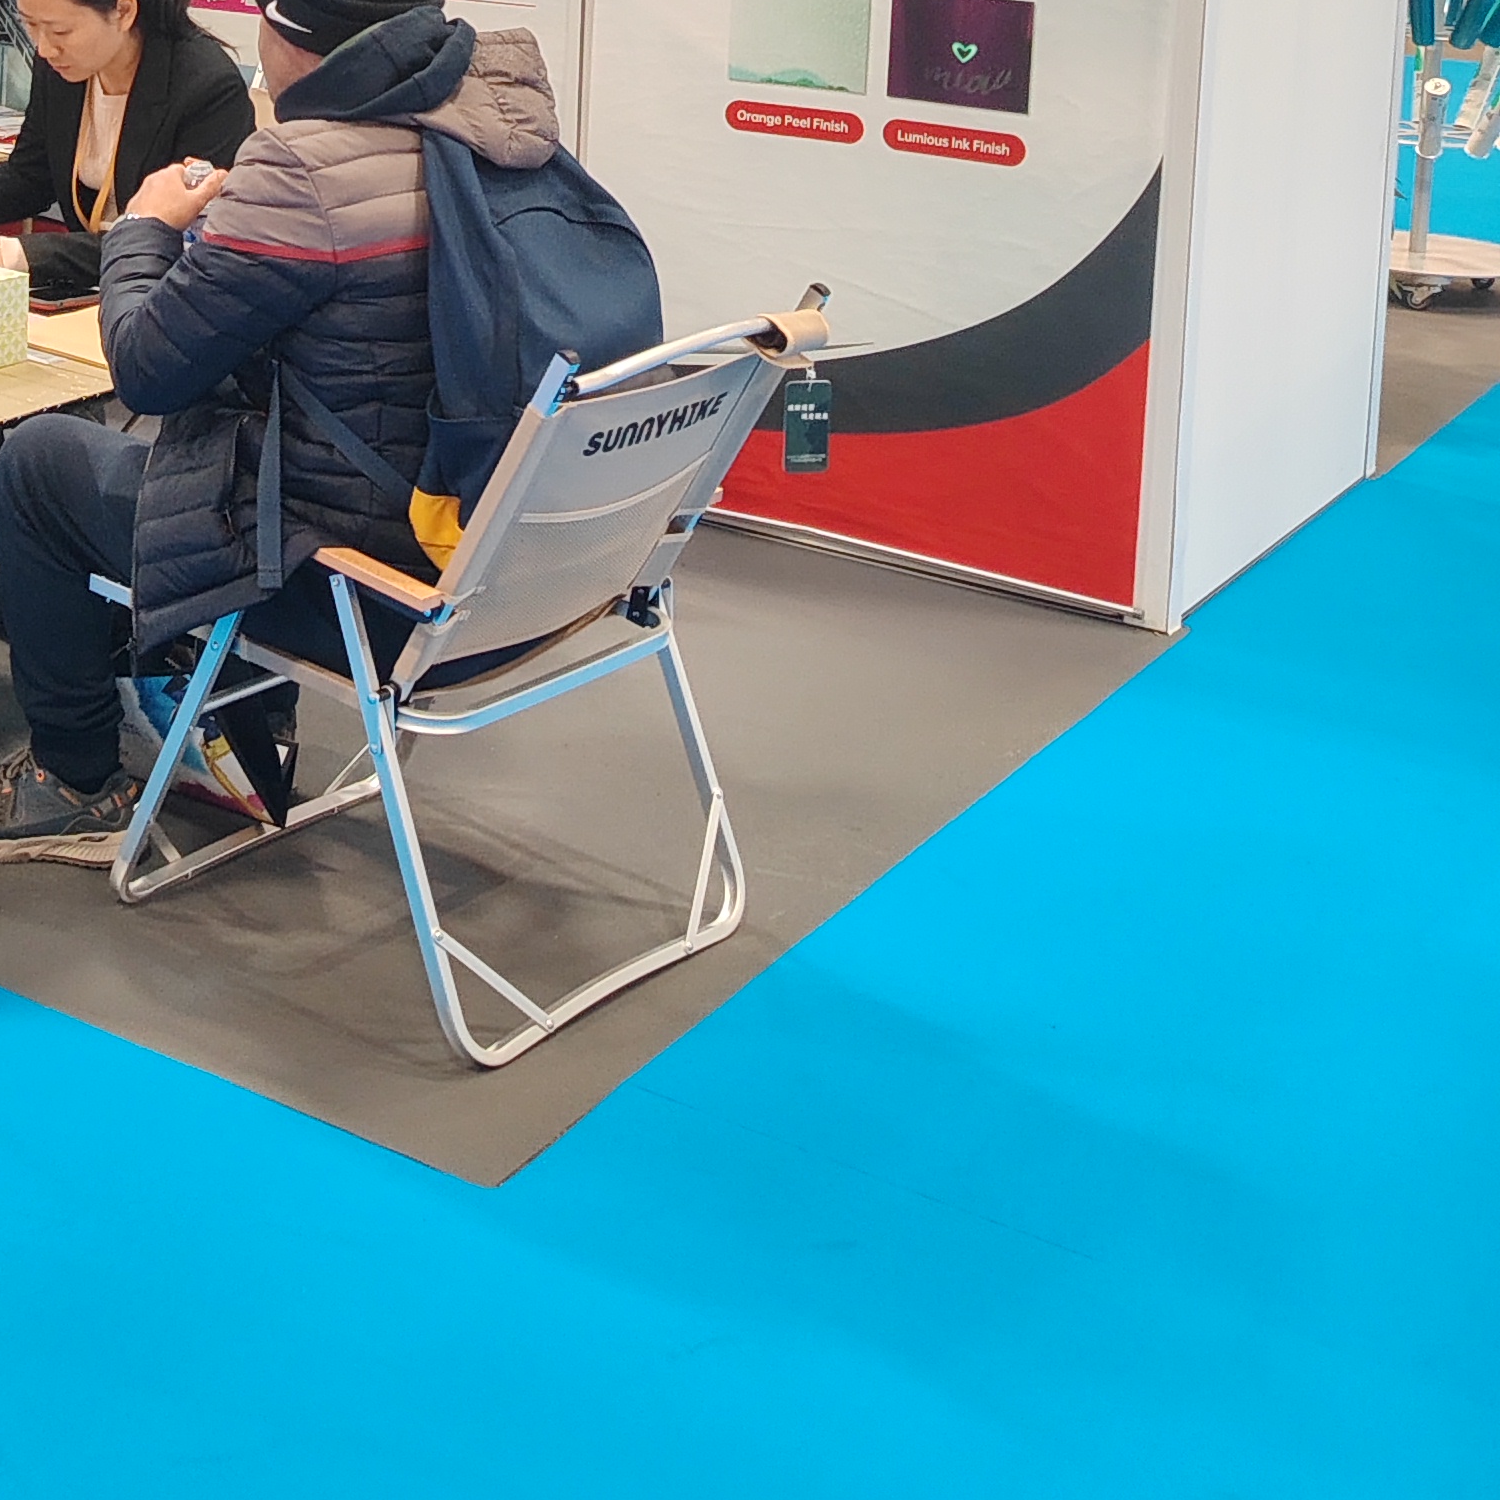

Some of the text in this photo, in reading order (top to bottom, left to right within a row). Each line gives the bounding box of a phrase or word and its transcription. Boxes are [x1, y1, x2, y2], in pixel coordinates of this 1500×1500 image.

[737, 110, 848, 134] Orange Peel Finish
[897, 130, 1010, 156] Lumious Ink Finish
[582, 391, 728, 456] SUNNYHIKE
